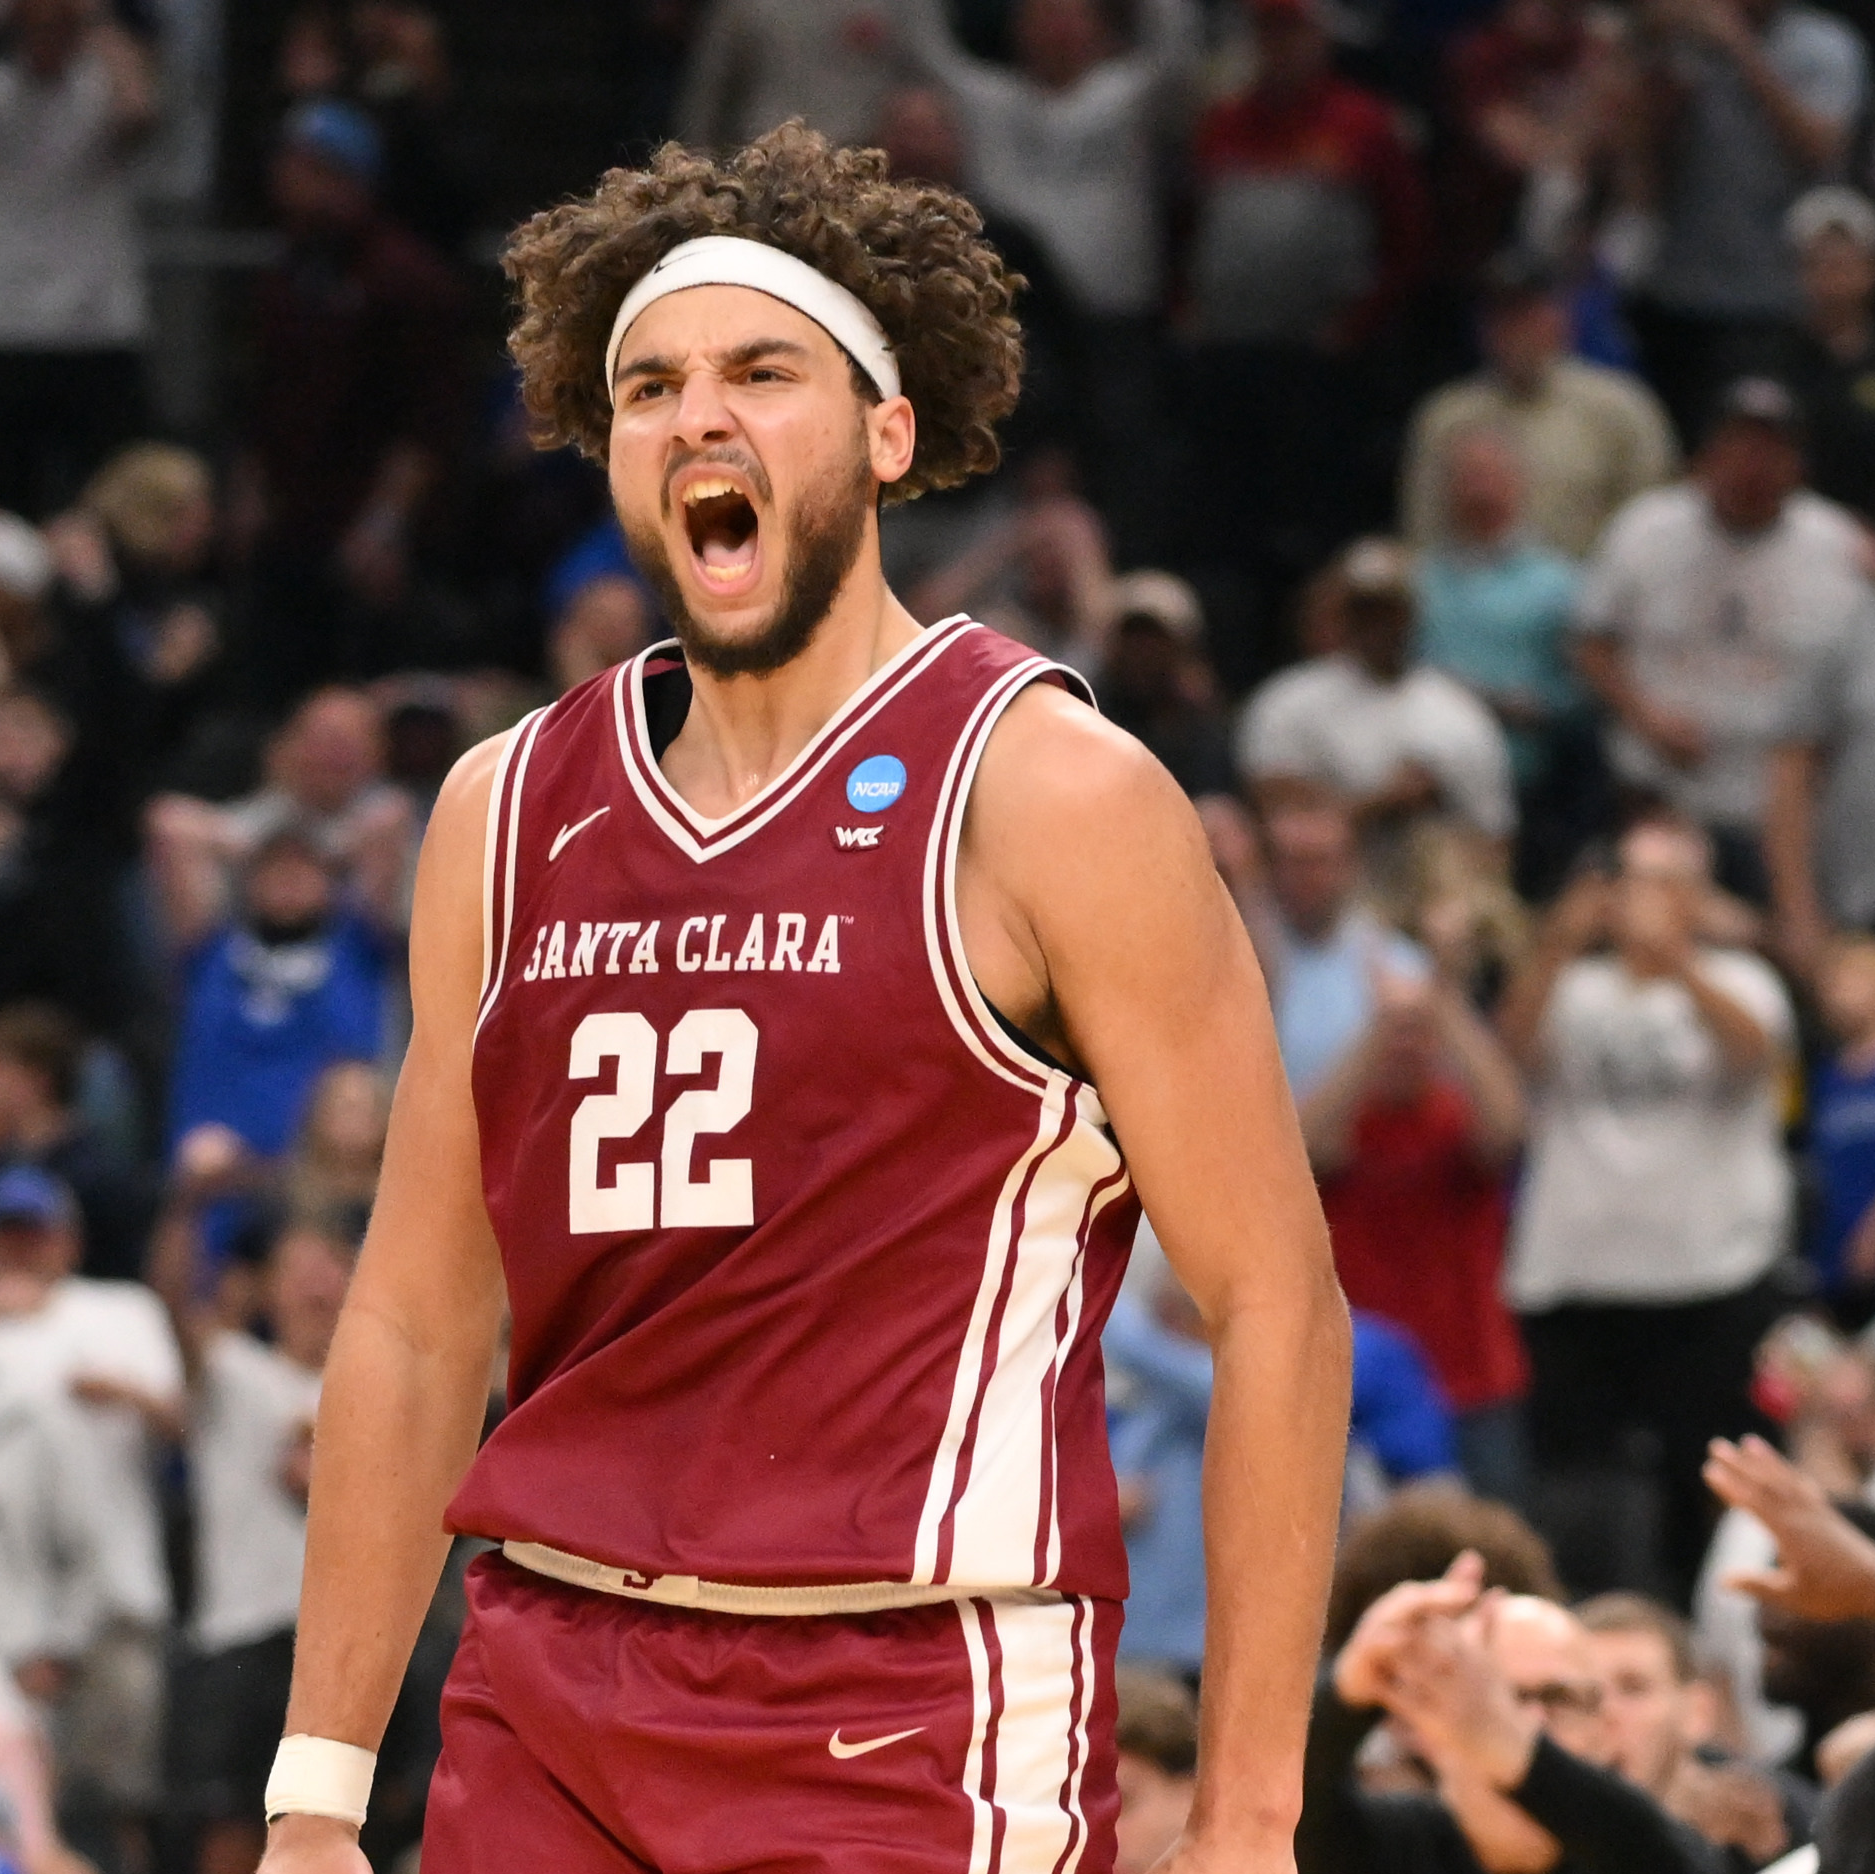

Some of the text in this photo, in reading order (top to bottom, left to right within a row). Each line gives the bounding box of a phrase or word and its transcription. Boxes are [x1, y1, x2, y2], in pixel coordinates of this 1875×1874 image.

[853, 782, 901, 797] NCAA
[834, 825, 885, 848] WCC
[523, 920, 661, 982] SANTA
[676, 912, 842, 973] CLARA
[568, 1008, 760, 1235] 22
